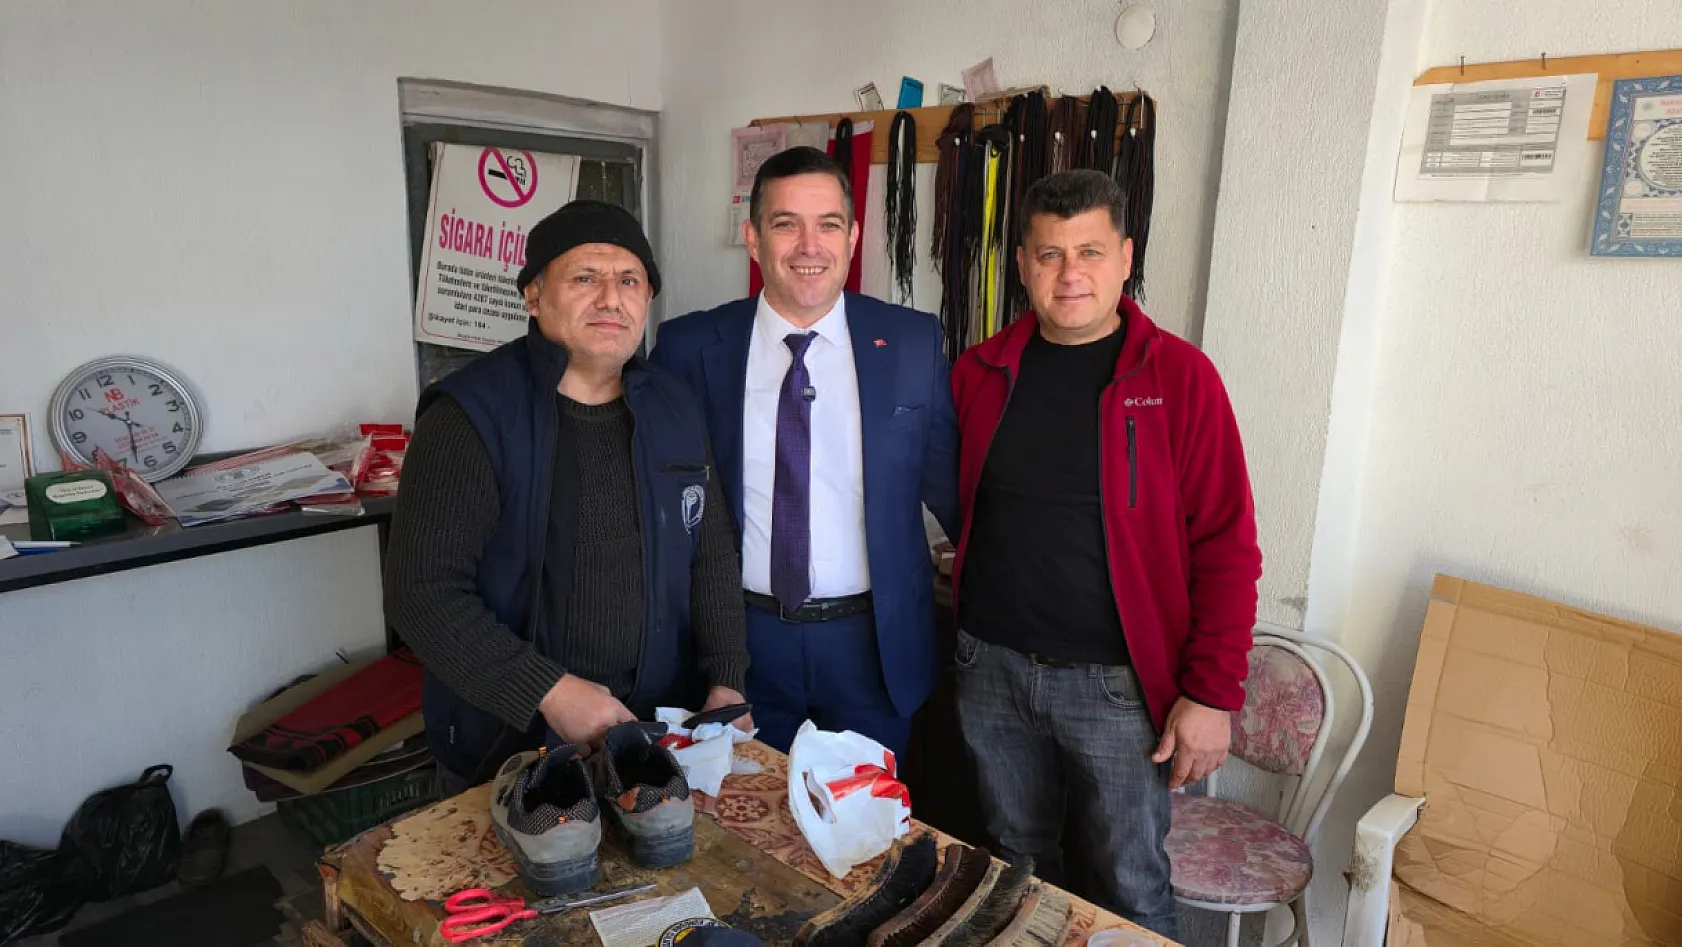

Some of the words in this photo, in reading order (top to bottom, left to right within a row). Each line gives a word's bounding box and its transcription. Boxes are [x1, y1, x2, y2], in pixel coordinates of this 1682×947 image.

[438, 207, 493, 259] SİGARA
[497, 220, 526, 272] İÇİL
[437, 260, 458, 274] Burada
[96, 375, 114, 388] 12
[127, 374, 136, 385] 1
[79, 387, 92, 400] 11
[148, 384, 163, 396] 2
[165, 399, 180, 412] 3
[1134, 396, 1163, 407] Colum
[68, 408, 84, 421] 10
[172, 421, 184, 433] 4
[72, 431, 87, 444] 9
[162, 441, 177, 453] 5
[143, 455, 158, 467] 6
